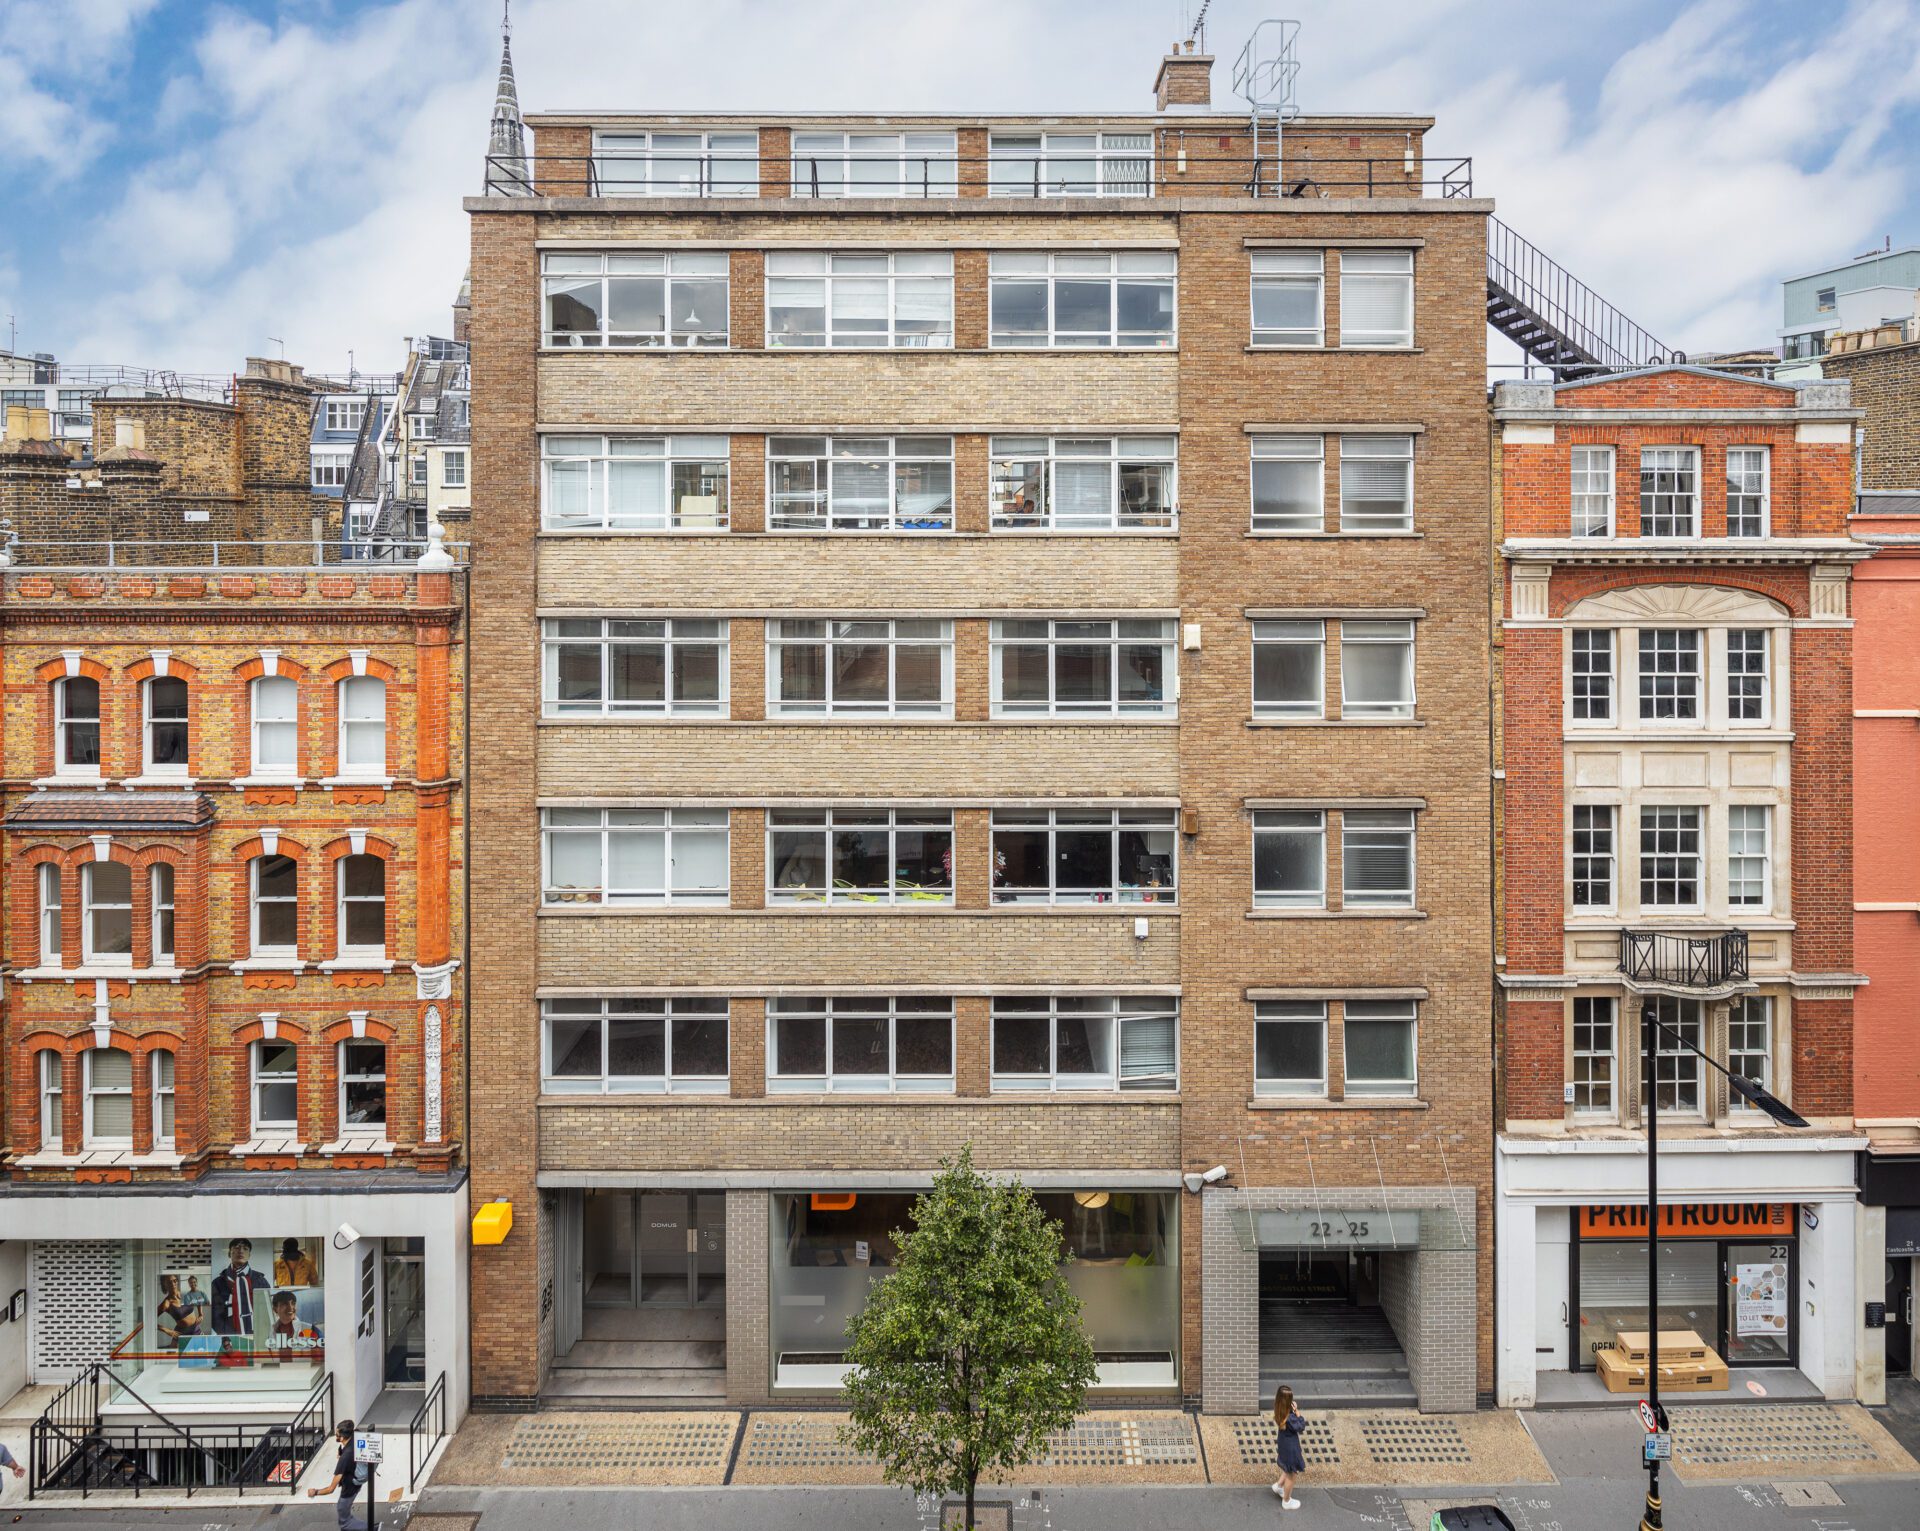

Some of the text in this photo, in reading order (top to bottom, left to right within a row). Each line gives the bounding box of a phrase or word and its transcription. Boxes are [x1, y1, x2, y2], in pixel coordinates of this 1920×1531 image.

[1310, 1222, 1331, 1237] 22
[1350, 1221, 1369, 1237] 25
[1769, 1246, 1787, 1258] 22
[264, 1332, 325, 1349] ellesse
[1591, 1342, 1617, 1353] OPEN
[1642, 1405, 1654, 1427] 20
